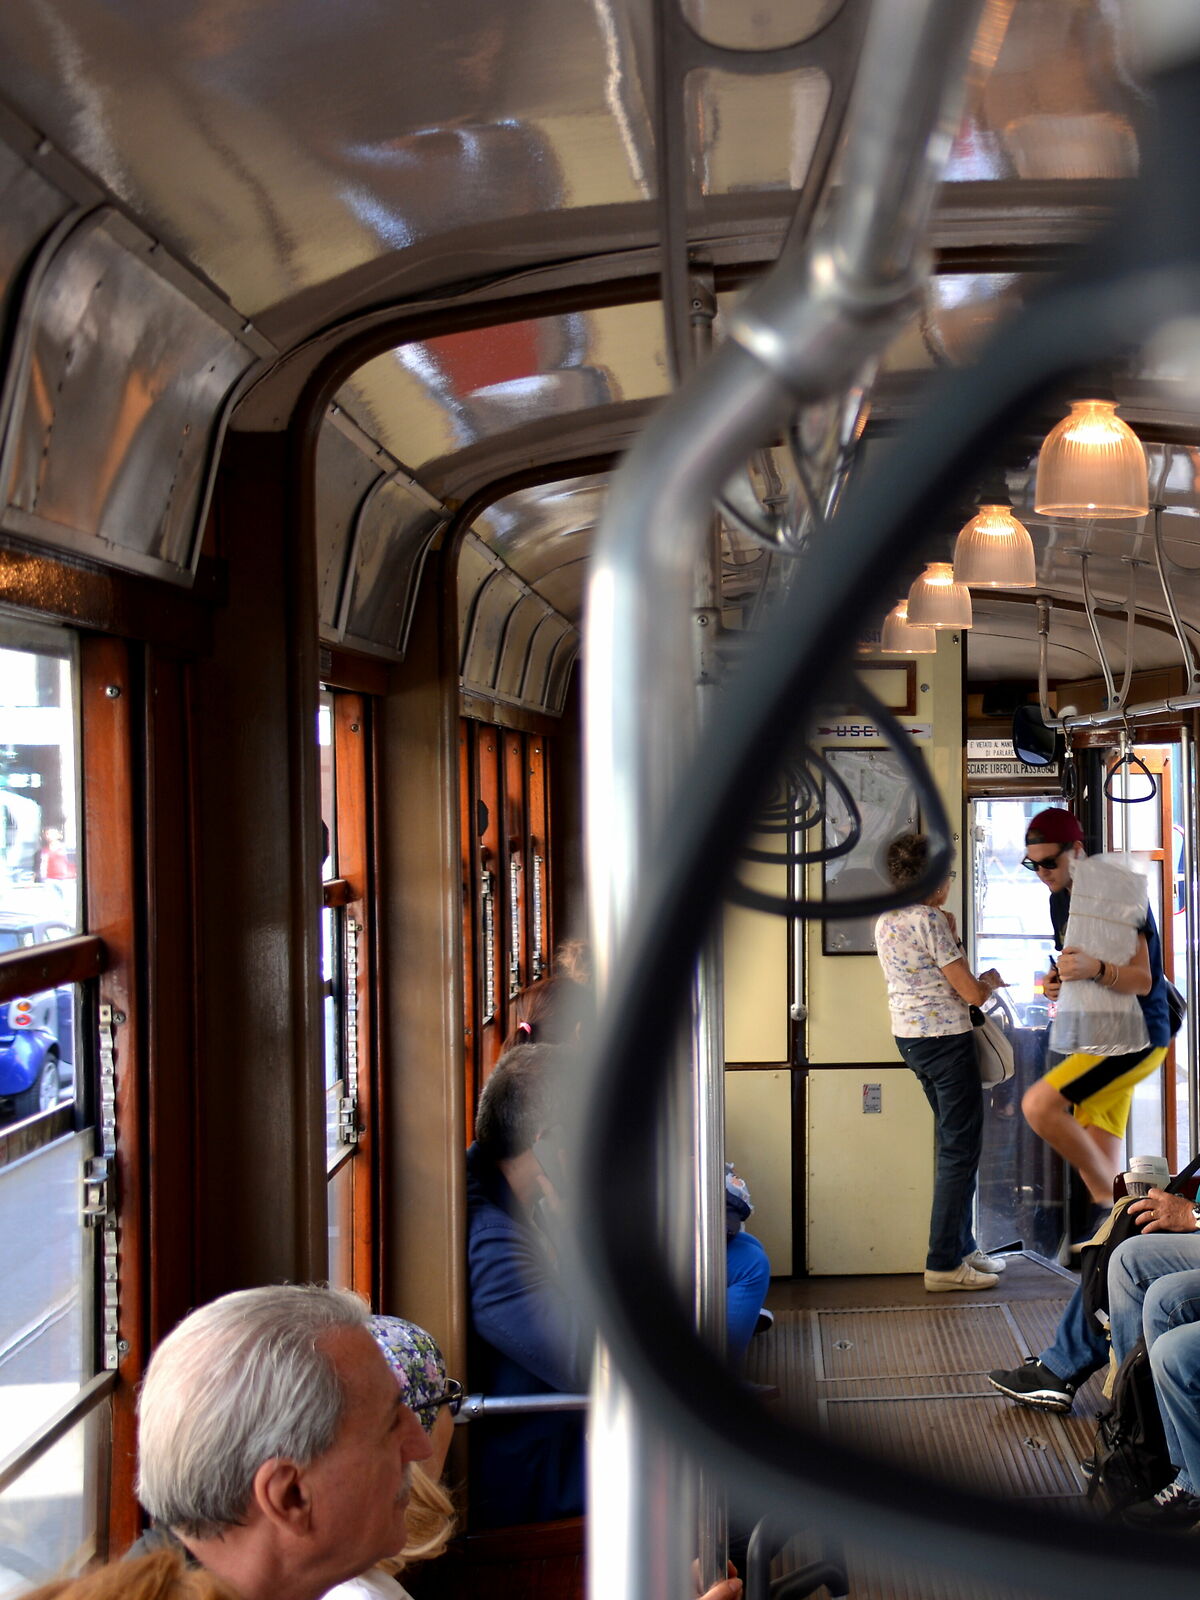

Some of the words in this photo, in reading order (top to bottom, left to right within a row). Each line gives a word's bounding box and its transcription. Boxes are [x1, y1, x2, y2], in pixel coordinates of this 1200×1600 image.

[836, 725, 880, 736] USCI
[967, 763, 989, 774] SCIARE
[990, 763, 1012, 774] LIBERO
[1013, 763, 1020, 774] IL
[1021, 763, 1056, 774] PASSAGGIO
